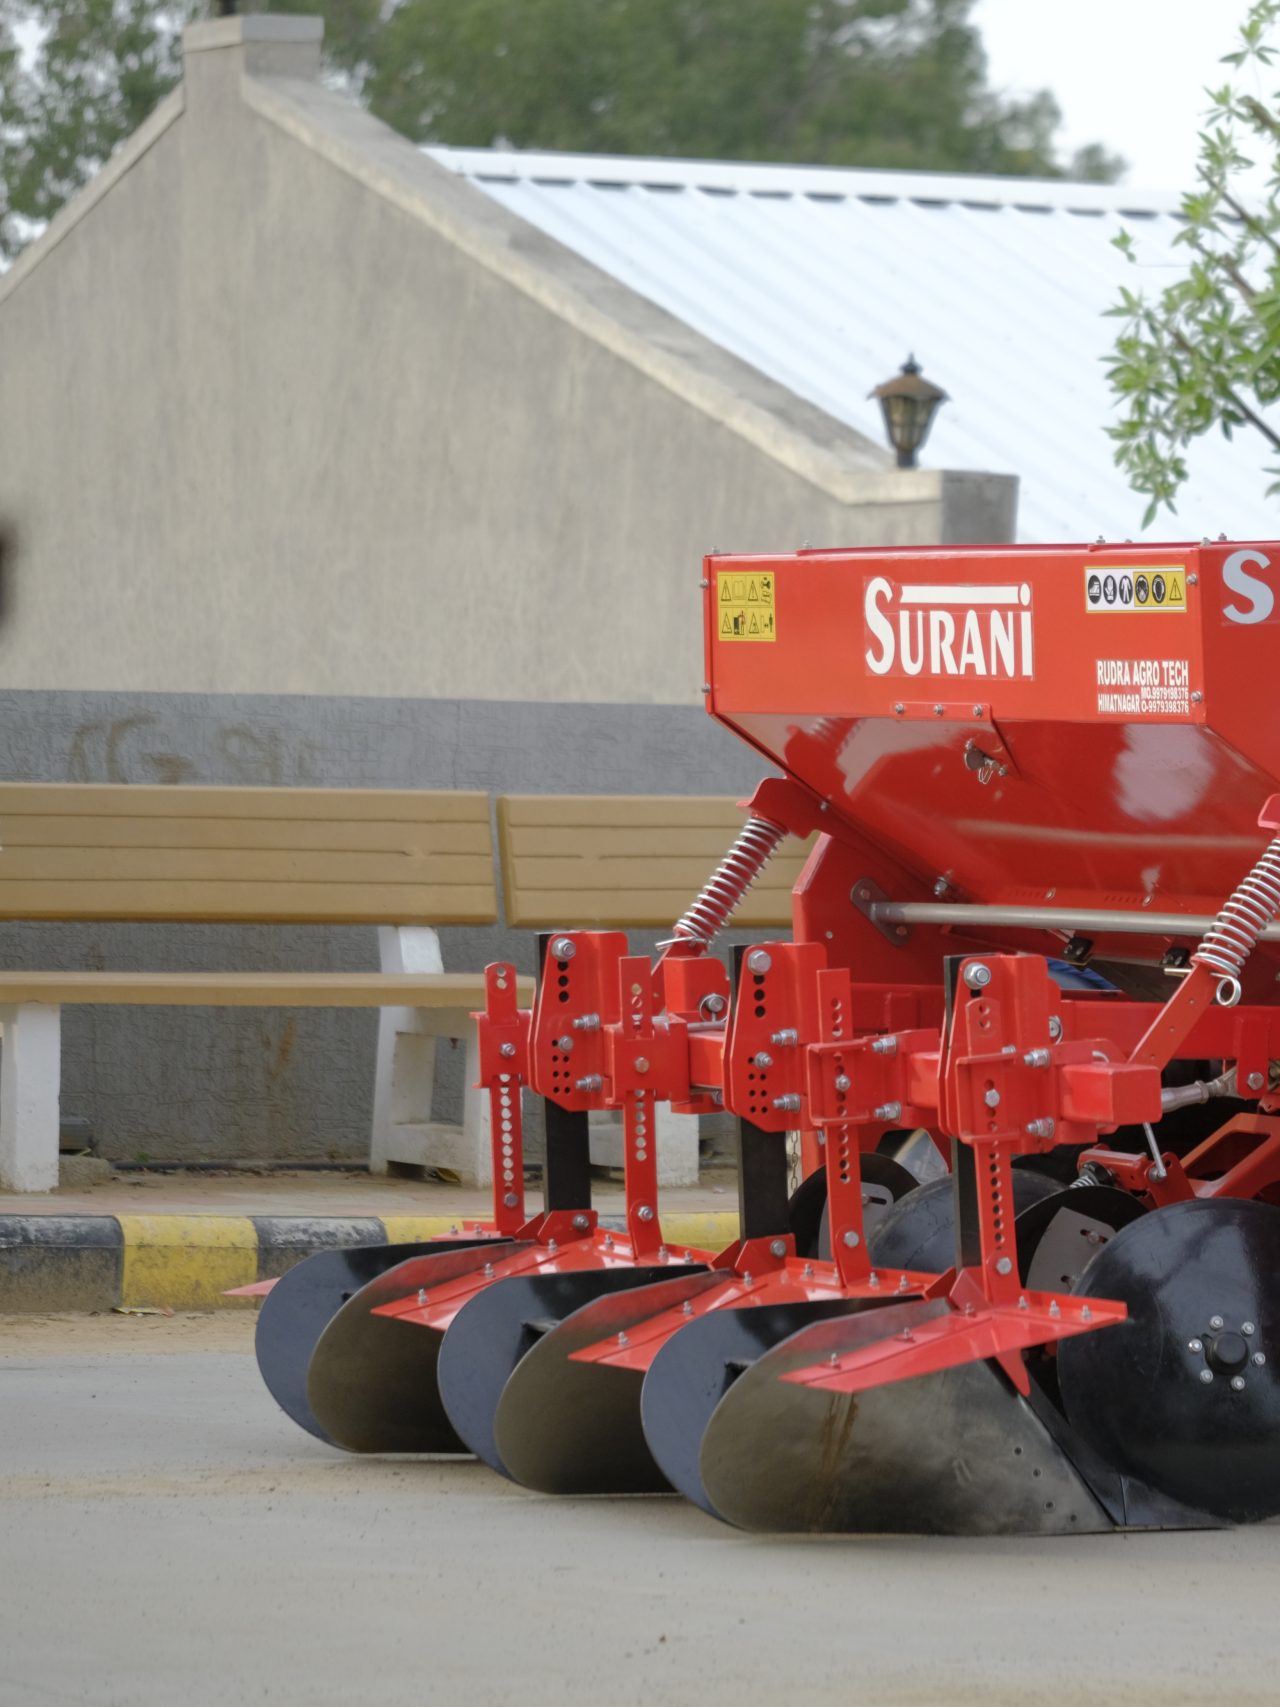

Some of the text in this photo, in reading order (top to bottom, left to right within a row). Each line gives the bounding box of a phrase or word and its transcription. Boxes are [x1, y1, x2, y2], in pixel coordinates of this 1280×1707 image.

[1097, 660, 1188, 686] RUDRA AGRO TECH
